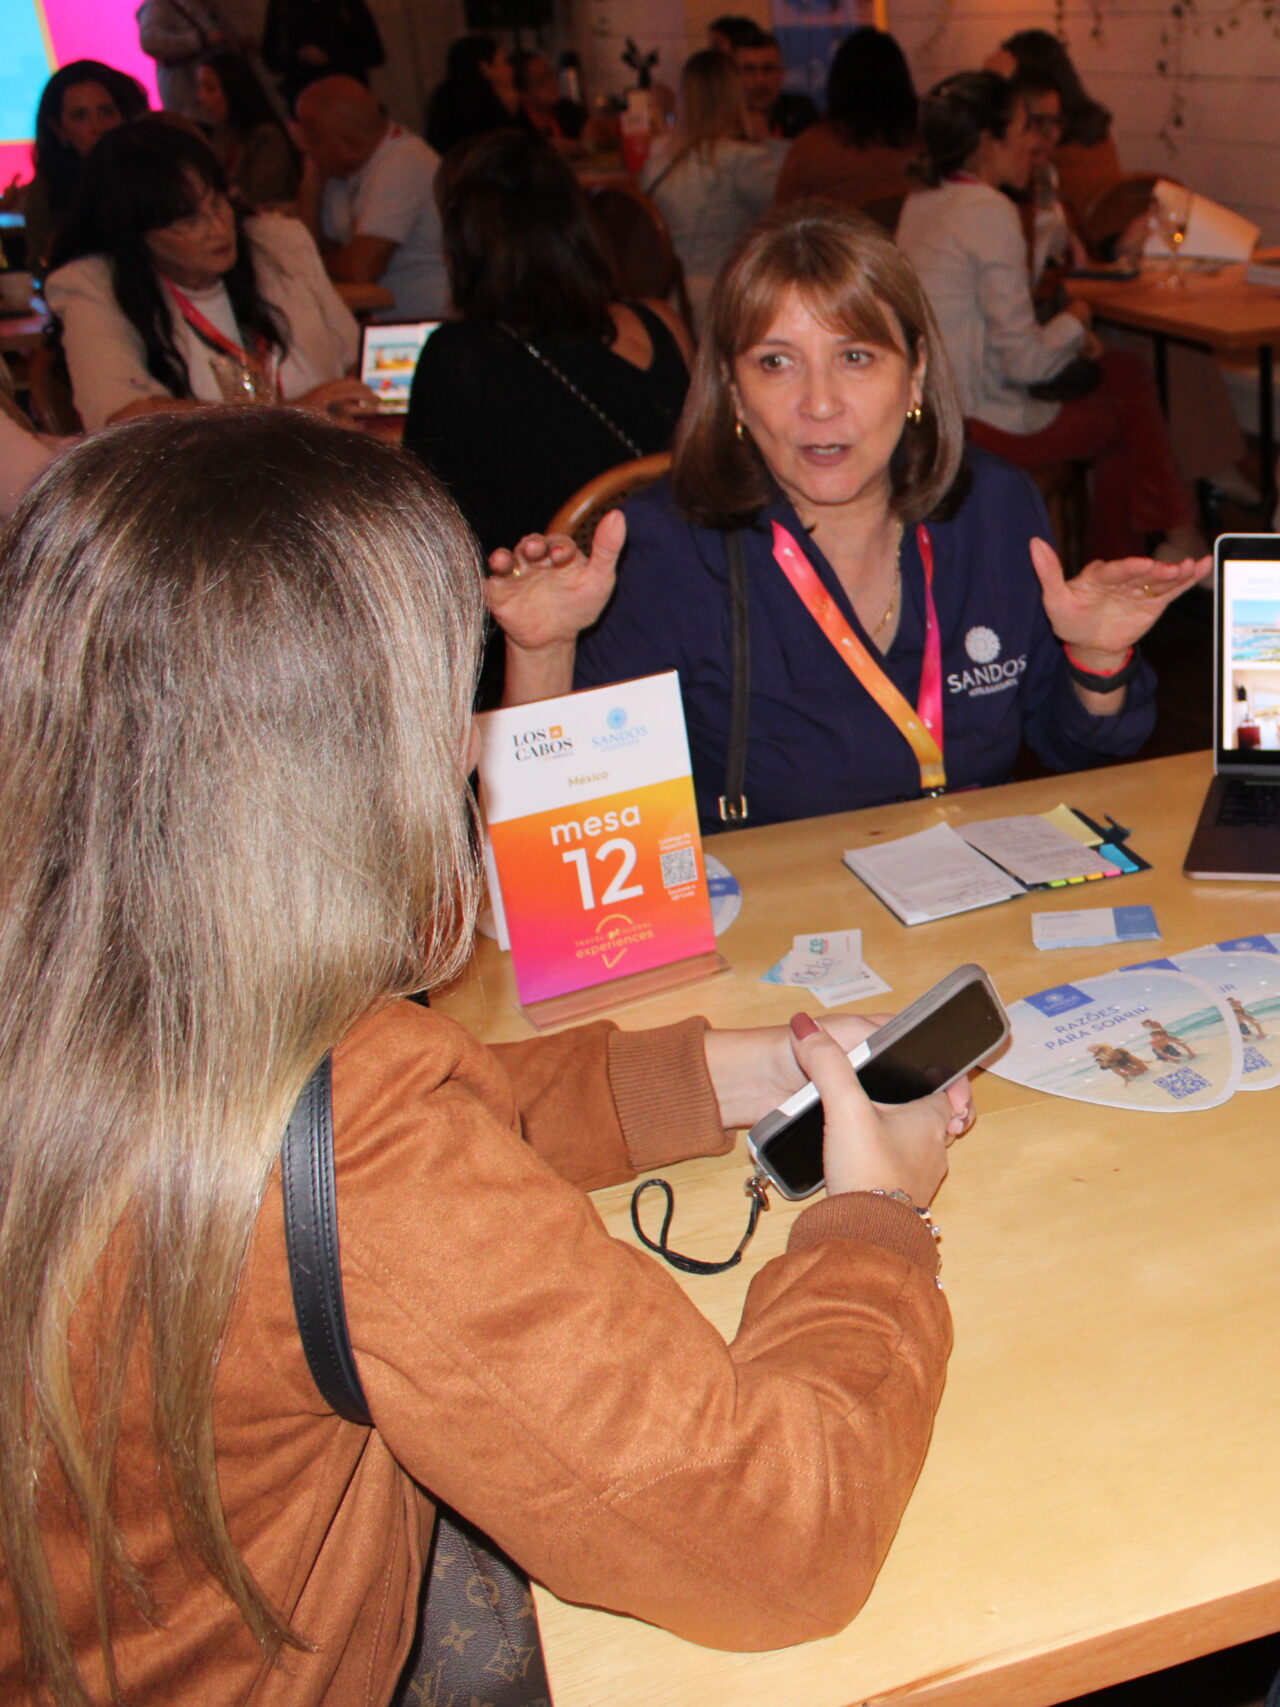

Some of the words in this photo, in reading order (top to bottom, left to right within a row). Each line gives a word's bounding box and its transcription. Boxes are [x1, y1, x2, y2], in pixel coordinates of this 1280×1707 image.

[947, 654, 1027, 694] SANDOS
[513, 728, 547, 748] LOS
[514, 738, 573, 761] CABOS
[590, 725, 648, 748] SANDOS
[567, 770, 610, 788] México
[550, 805, 641, 846] mesa
[562, 838, 644, 910] 12
[576, 929, 655, 959] experiences
[1044, 1030, 1091, 1050] PARA
[1091, 1005, 1152, 1032] SORRIR
[1054, 1005, 1120, 1034] RAZÕES
